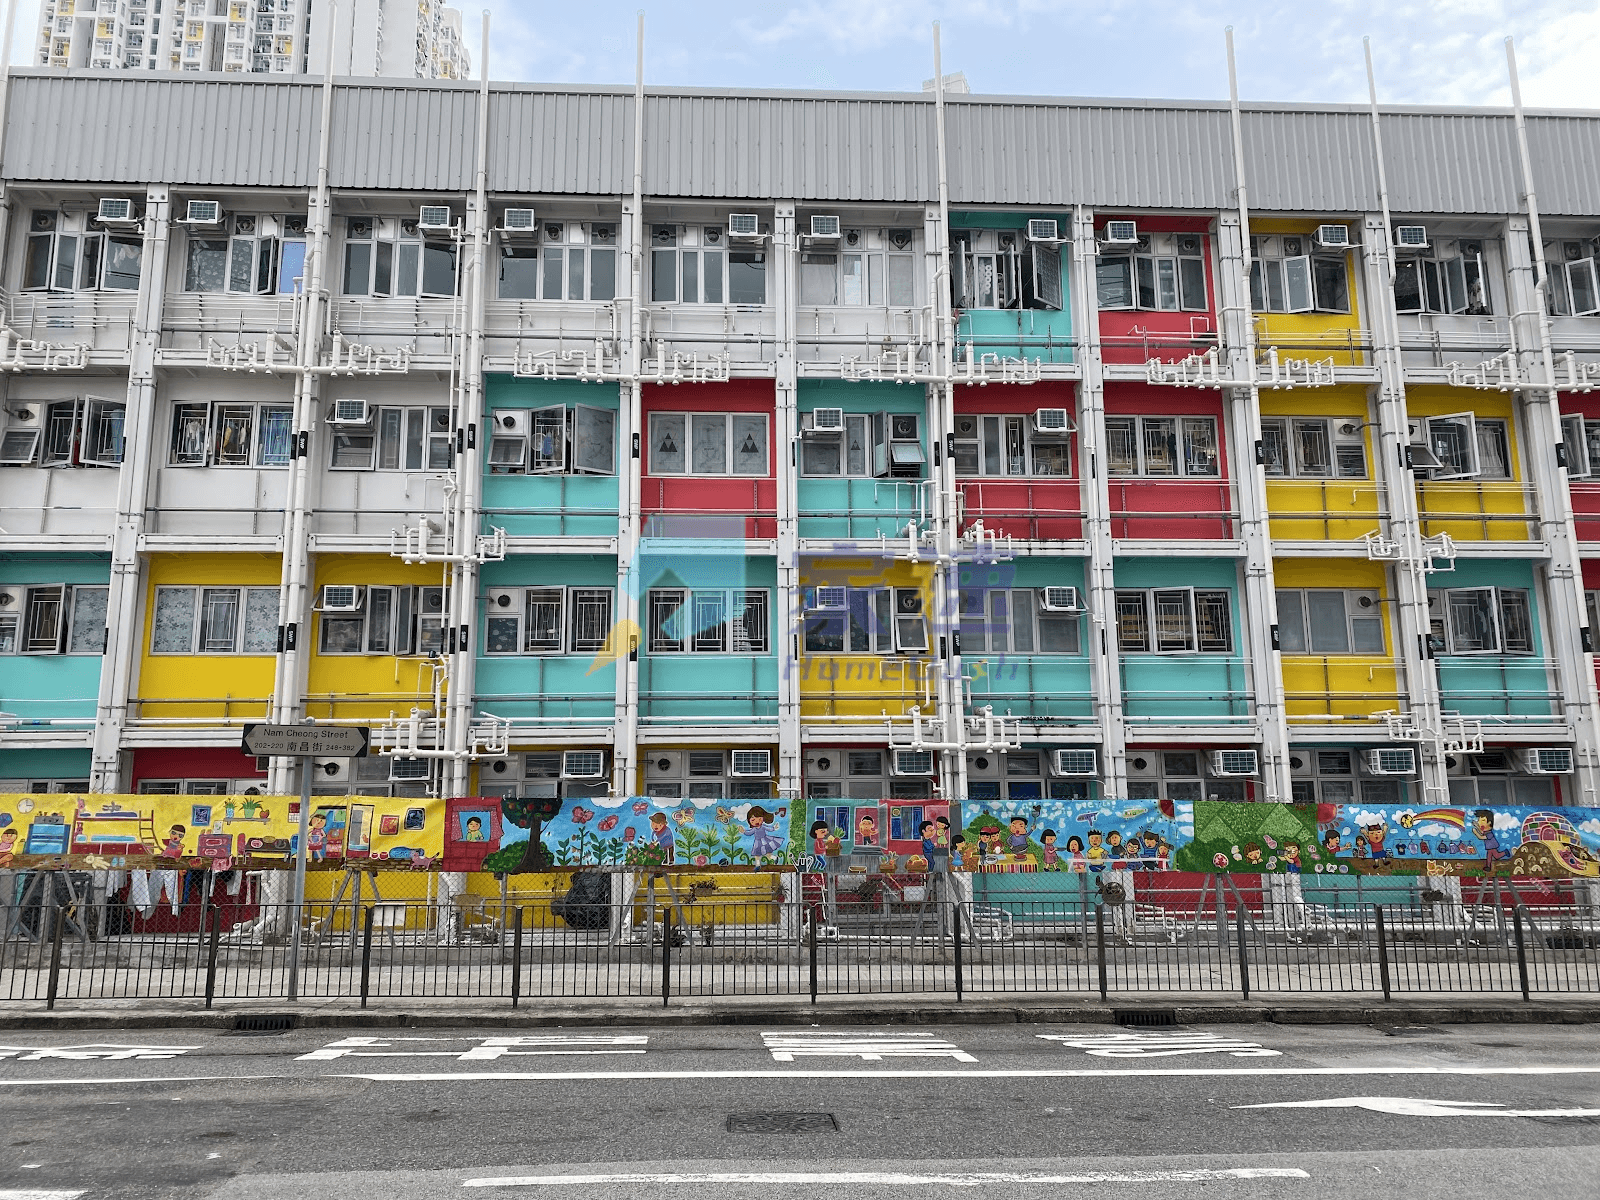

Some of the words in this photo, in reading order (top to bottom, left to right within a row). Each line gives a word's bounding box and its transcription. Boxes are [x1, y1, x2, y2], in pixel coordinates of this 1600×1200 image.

[263, 728, 284, 737] Nam
[286, 729, 318, 739] Cheong
[321, 730, 349, 739] Street
[286, 741, 323, 752] 南昌街
[760, 1031, 980, 1062] LANE
[1035, 1031, 1284, 1058] BUS
